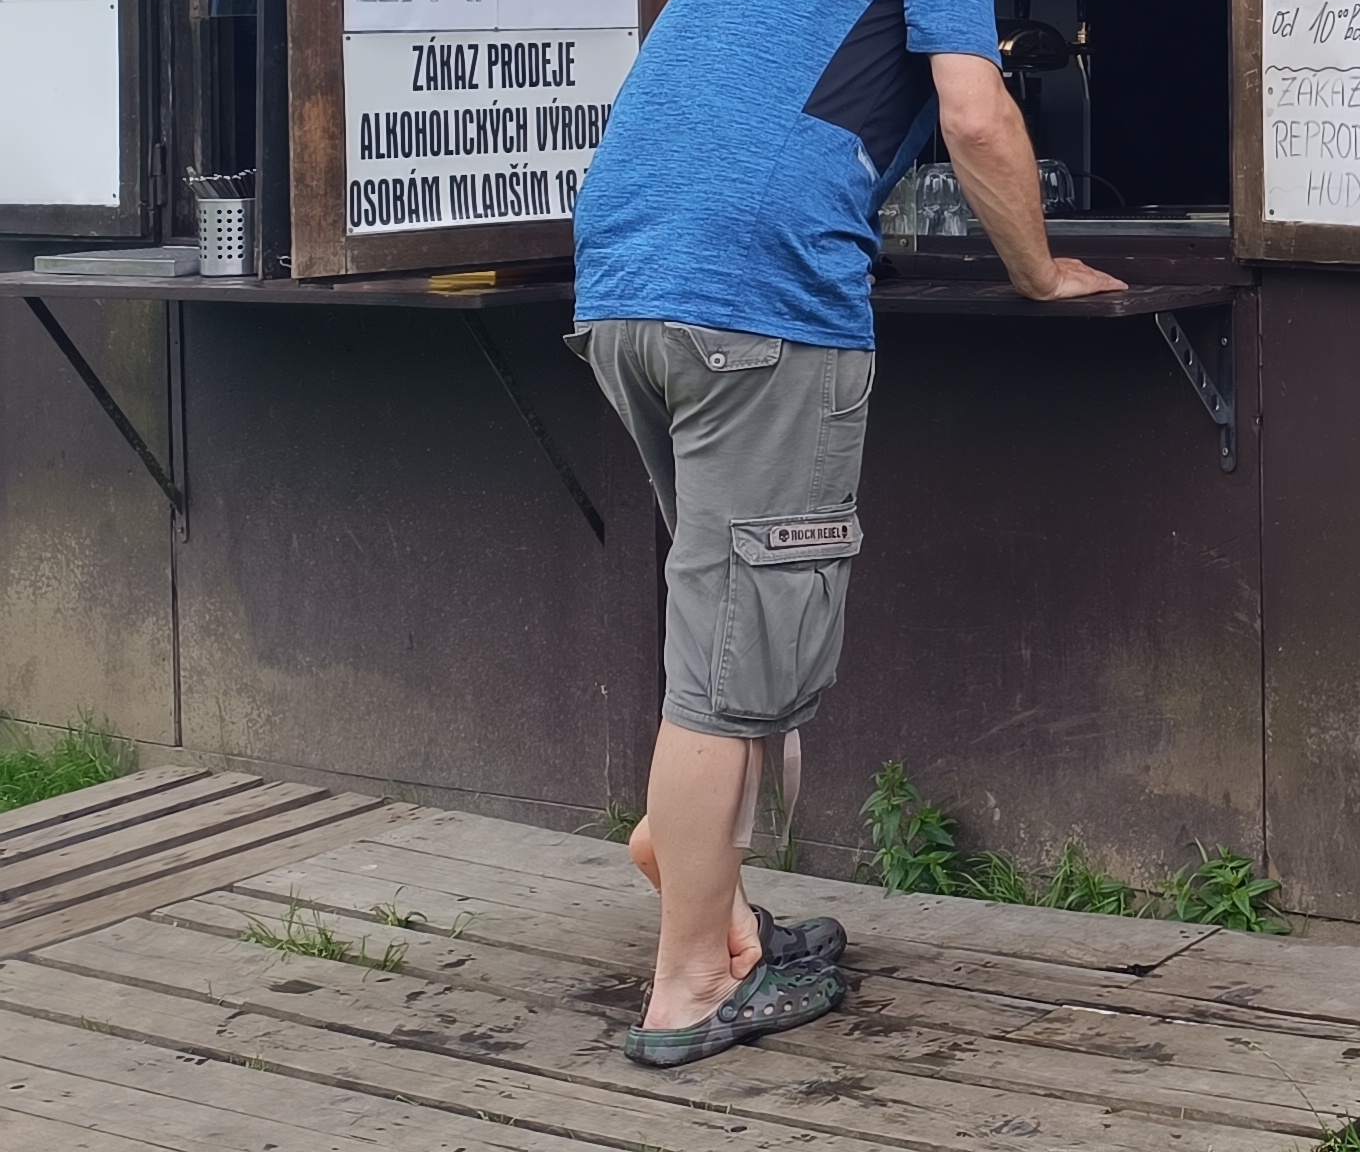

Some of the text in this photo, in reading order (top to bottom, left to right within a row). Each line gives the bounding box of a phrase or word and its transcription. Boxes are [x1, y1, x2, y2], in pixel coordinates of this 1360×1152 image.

[412, 36, 577, 92] ZÁKAZ PRODEJE
[360, 97, 615, 161] ALKOHOLICKÝCH VÝROBK
[350, 168, 443, 228] OSOBÁM
[449, 162, 551, 221] MLADŠÍM
[791, 528, 816, 542] ROCK
